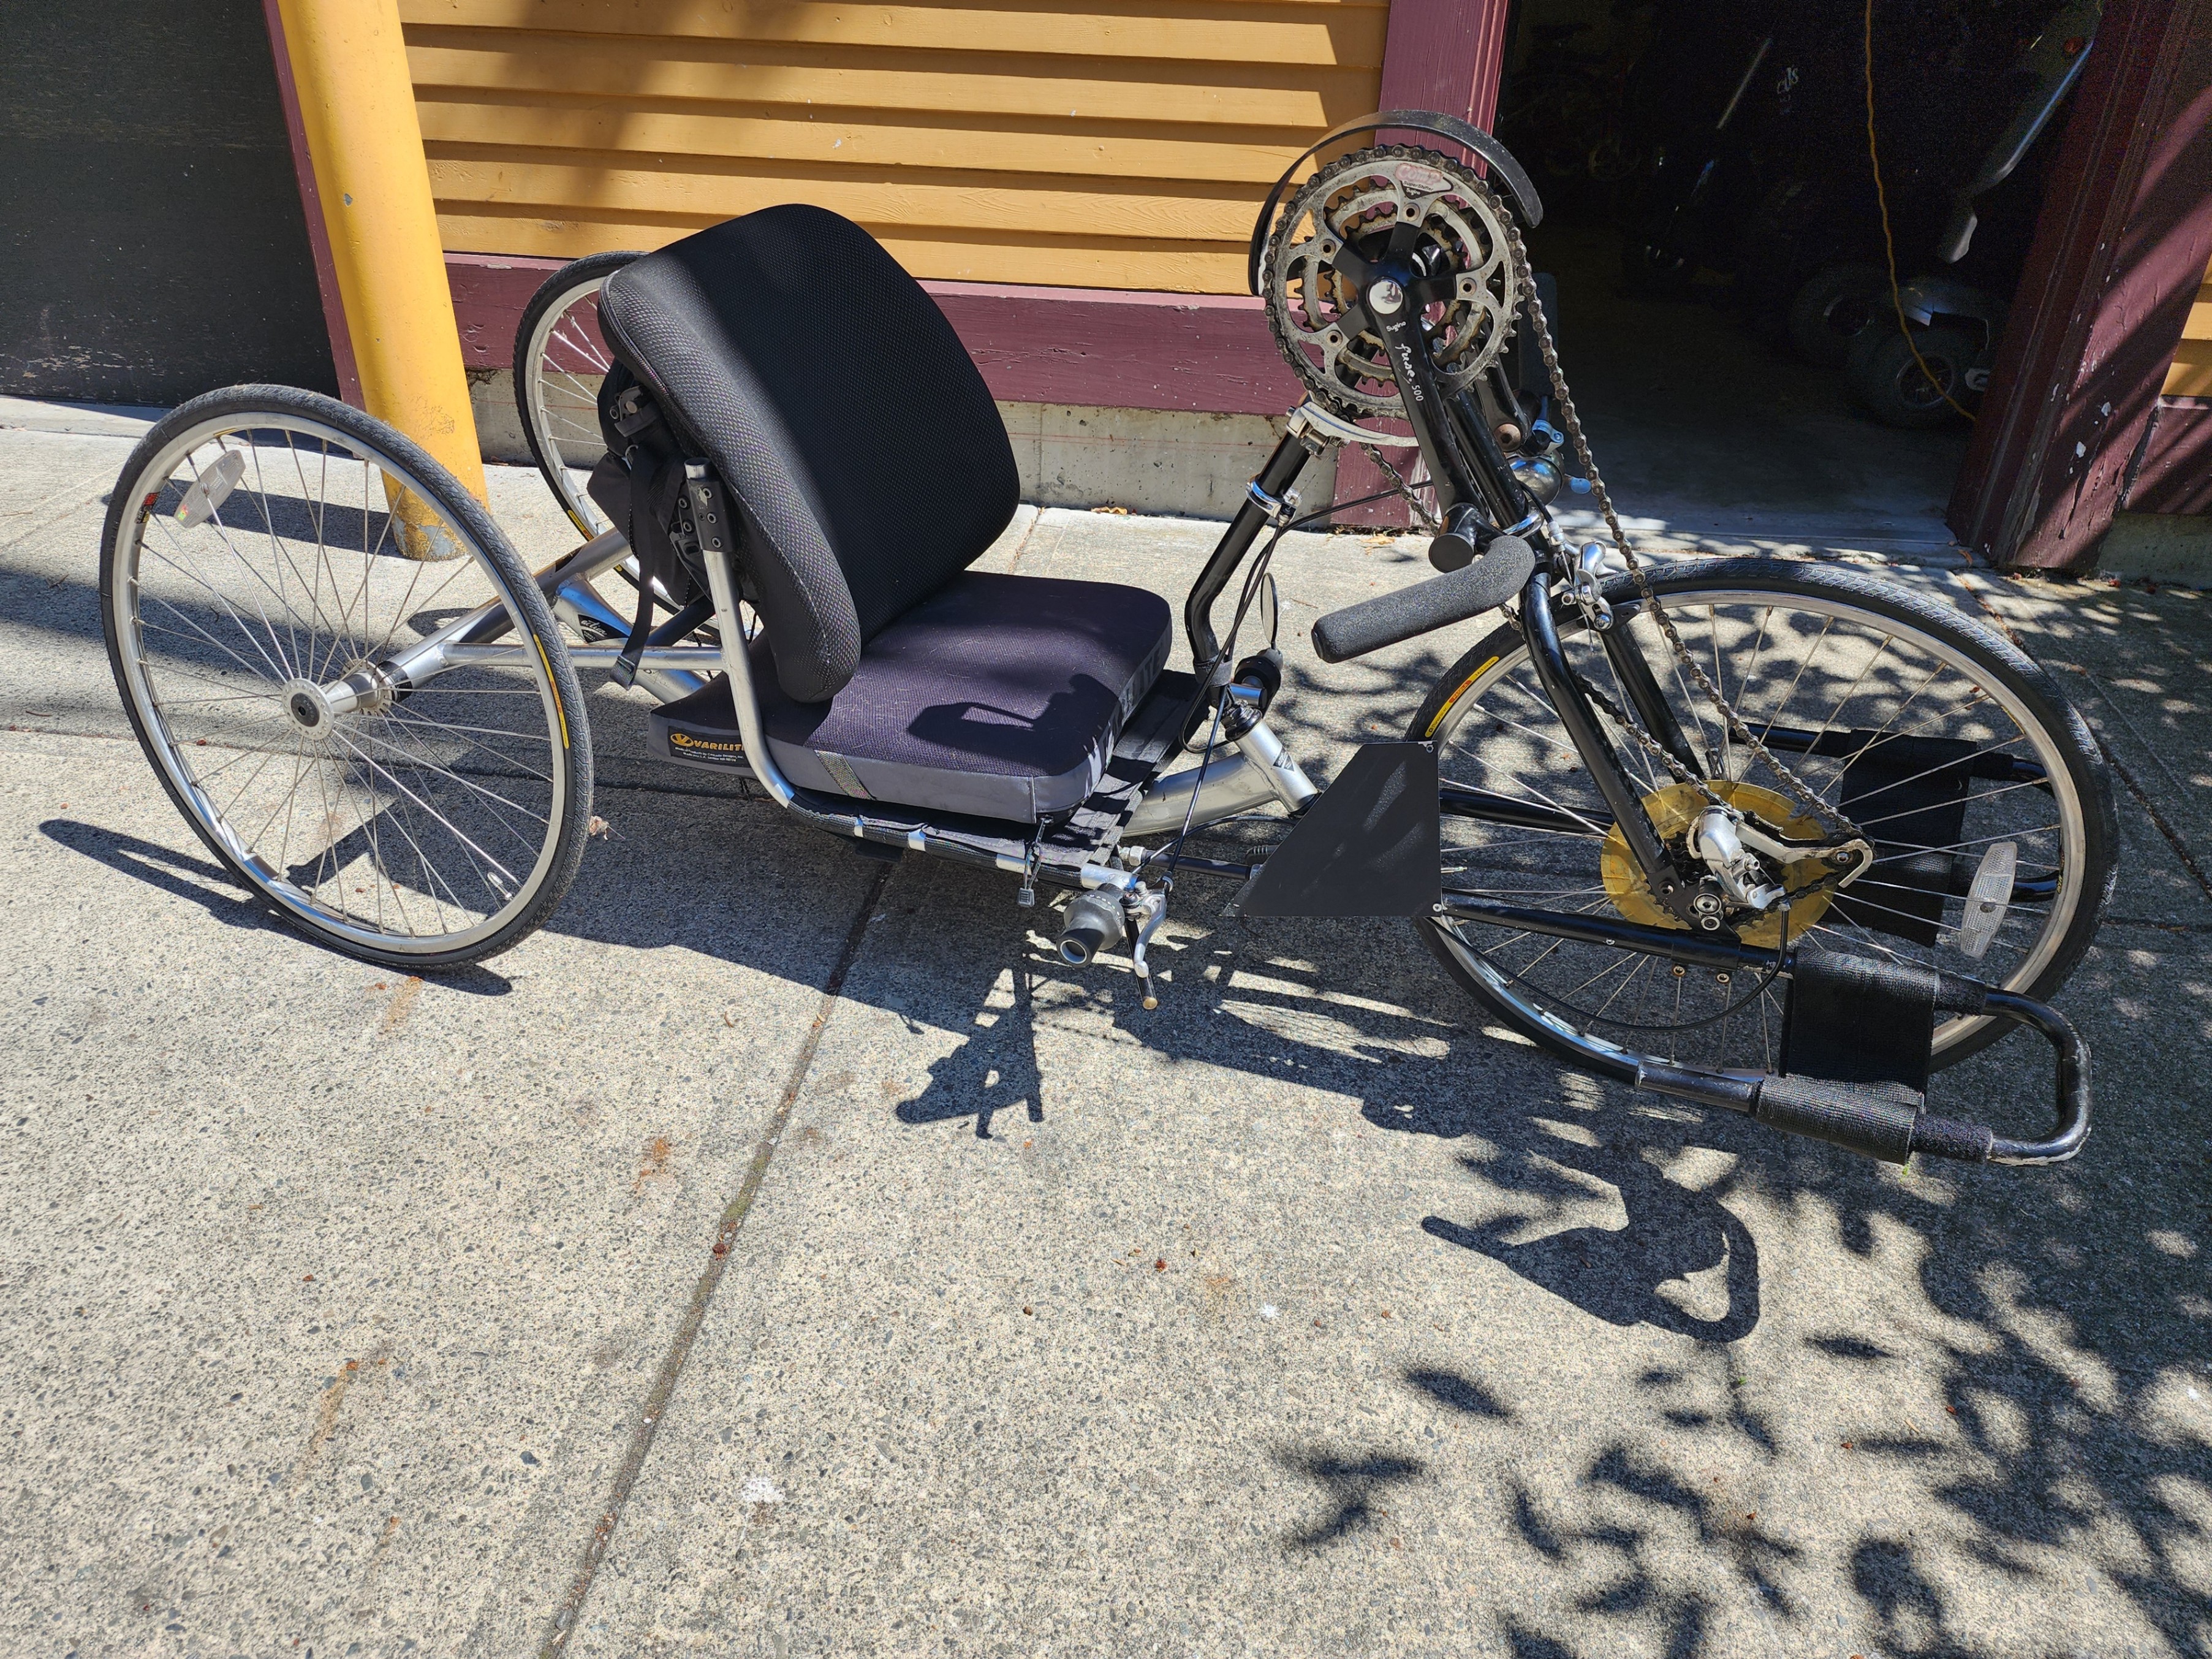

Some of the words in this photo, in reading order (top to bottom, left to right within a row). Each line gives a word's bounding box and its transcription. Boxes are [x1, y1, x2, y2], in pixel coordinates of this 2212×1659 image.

[1386, 321, 1406, 332] Sugino
[1412, 384, 1424, 401] 500
[581, 620, 607, 636] action
